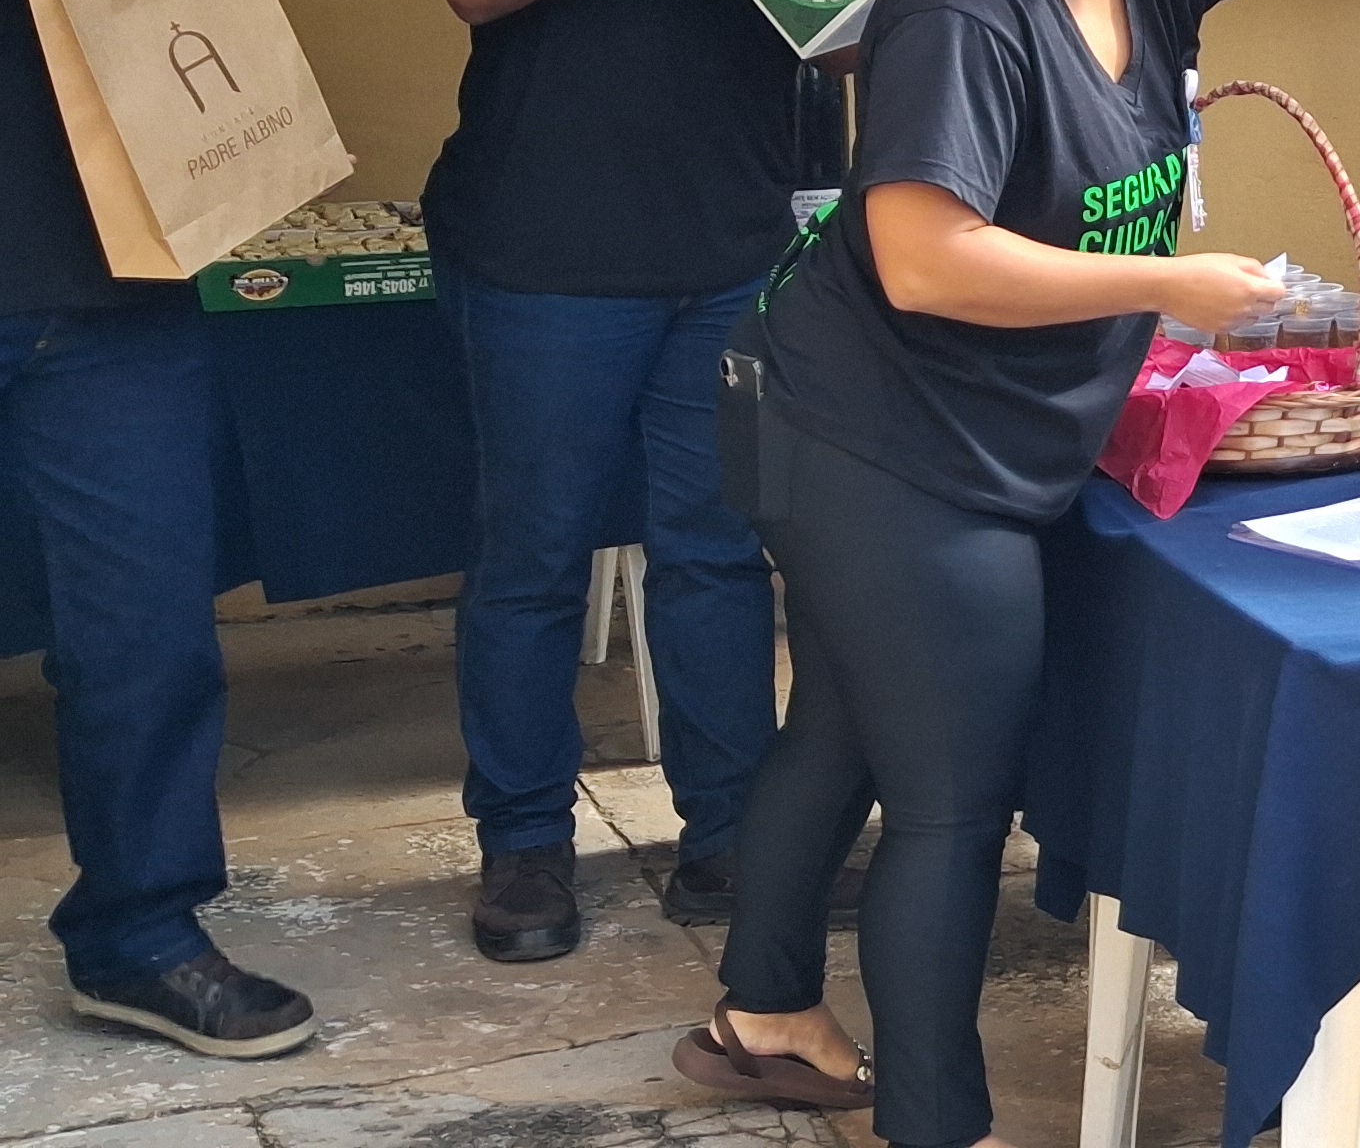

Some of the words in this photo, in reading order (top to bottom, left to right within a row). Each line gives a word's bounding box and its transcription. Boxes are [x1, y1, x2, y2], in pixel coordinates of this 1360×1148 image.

[187, 136, 241, 181] PADRE
[243, 105, 293, 150] ALBINO
[1082, 149, 1186, 223] SEGURA
[345, 277, 417, 298] 3045-1464
